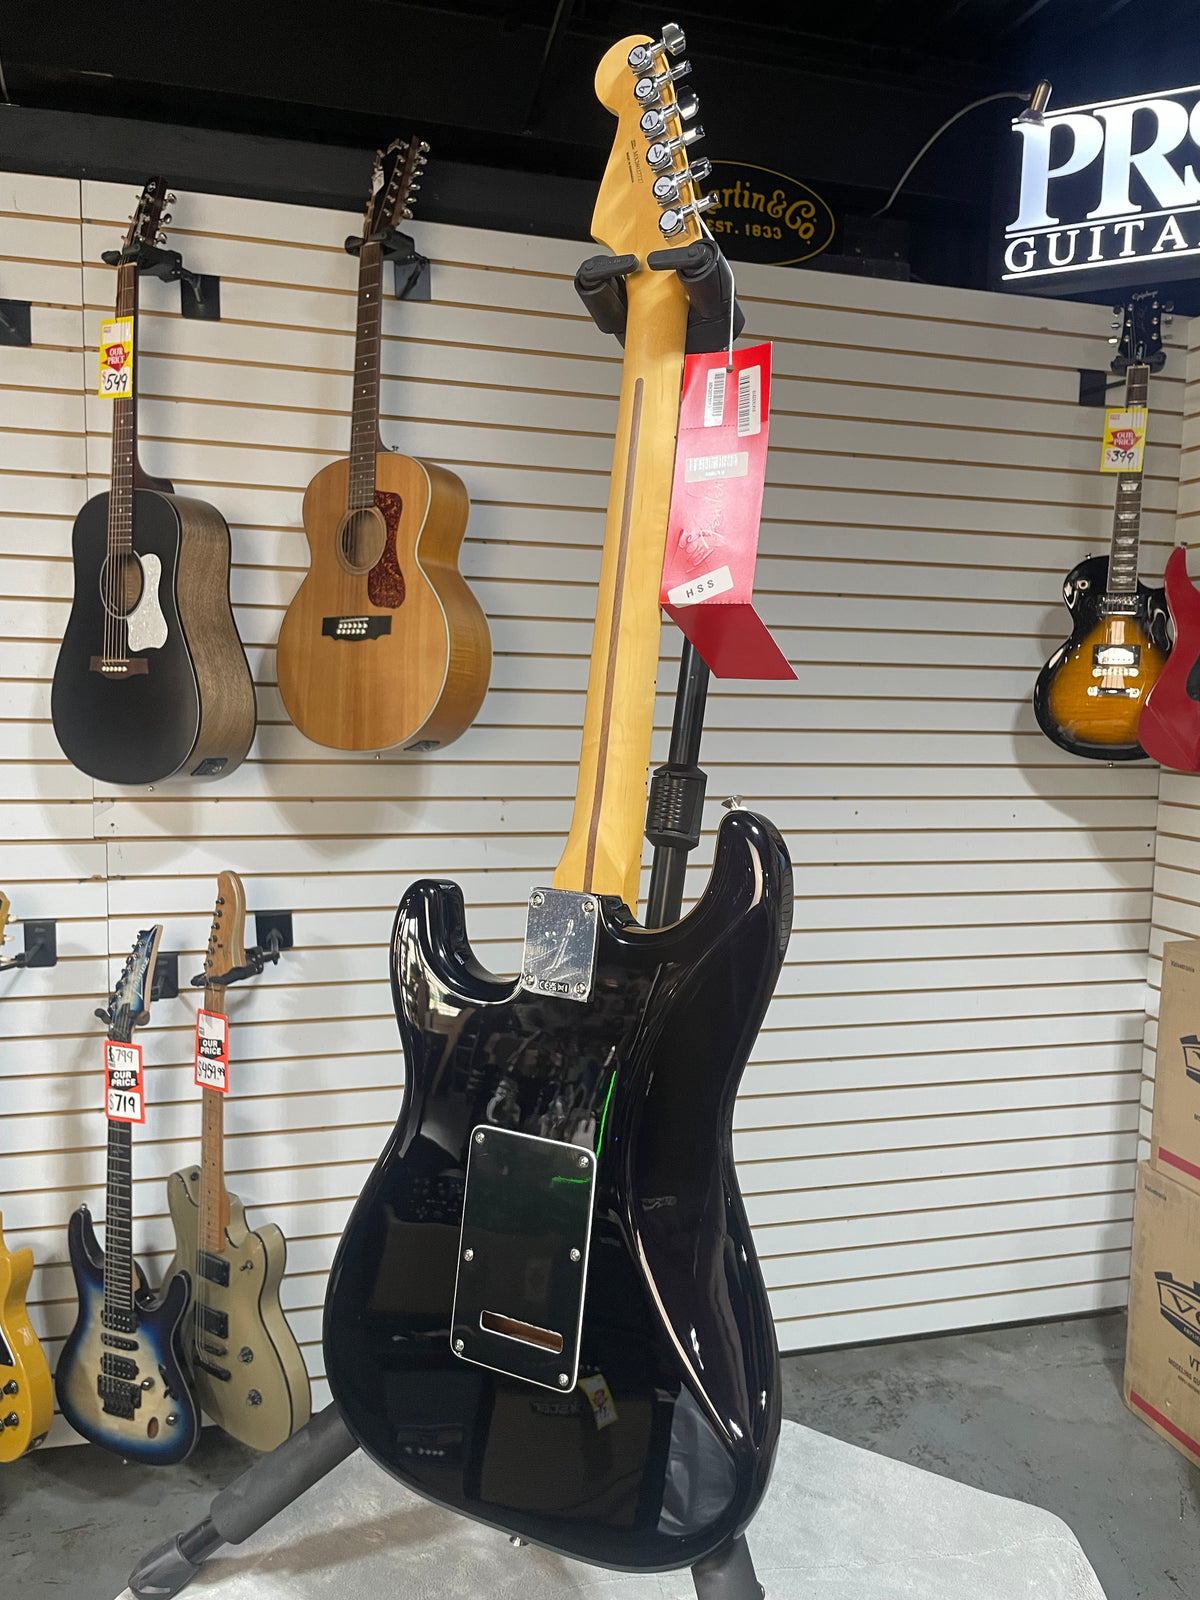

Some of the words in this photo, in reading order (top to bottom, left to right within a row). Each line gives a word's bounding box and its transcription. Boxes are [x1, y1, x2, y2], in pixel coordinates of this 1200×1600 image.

[1005, 99, 1200, 232] PR
[745, 223, 782, 240] 1833
[1004, 215, 1200, 273] GUITA
[109, 347, 124, 356] OUR
[107, 355, 125, 365] PRICE
[1105, 450, 1134, 463] $399
[202, 1039, 218, 1048] OUR
[200, 1047, 222, 1056] PRICE
[113, 1071, 132, 1079] OUR
[110, 1078, 136, 1087] PRICE
[108, 1093, 136, 1113] $719
